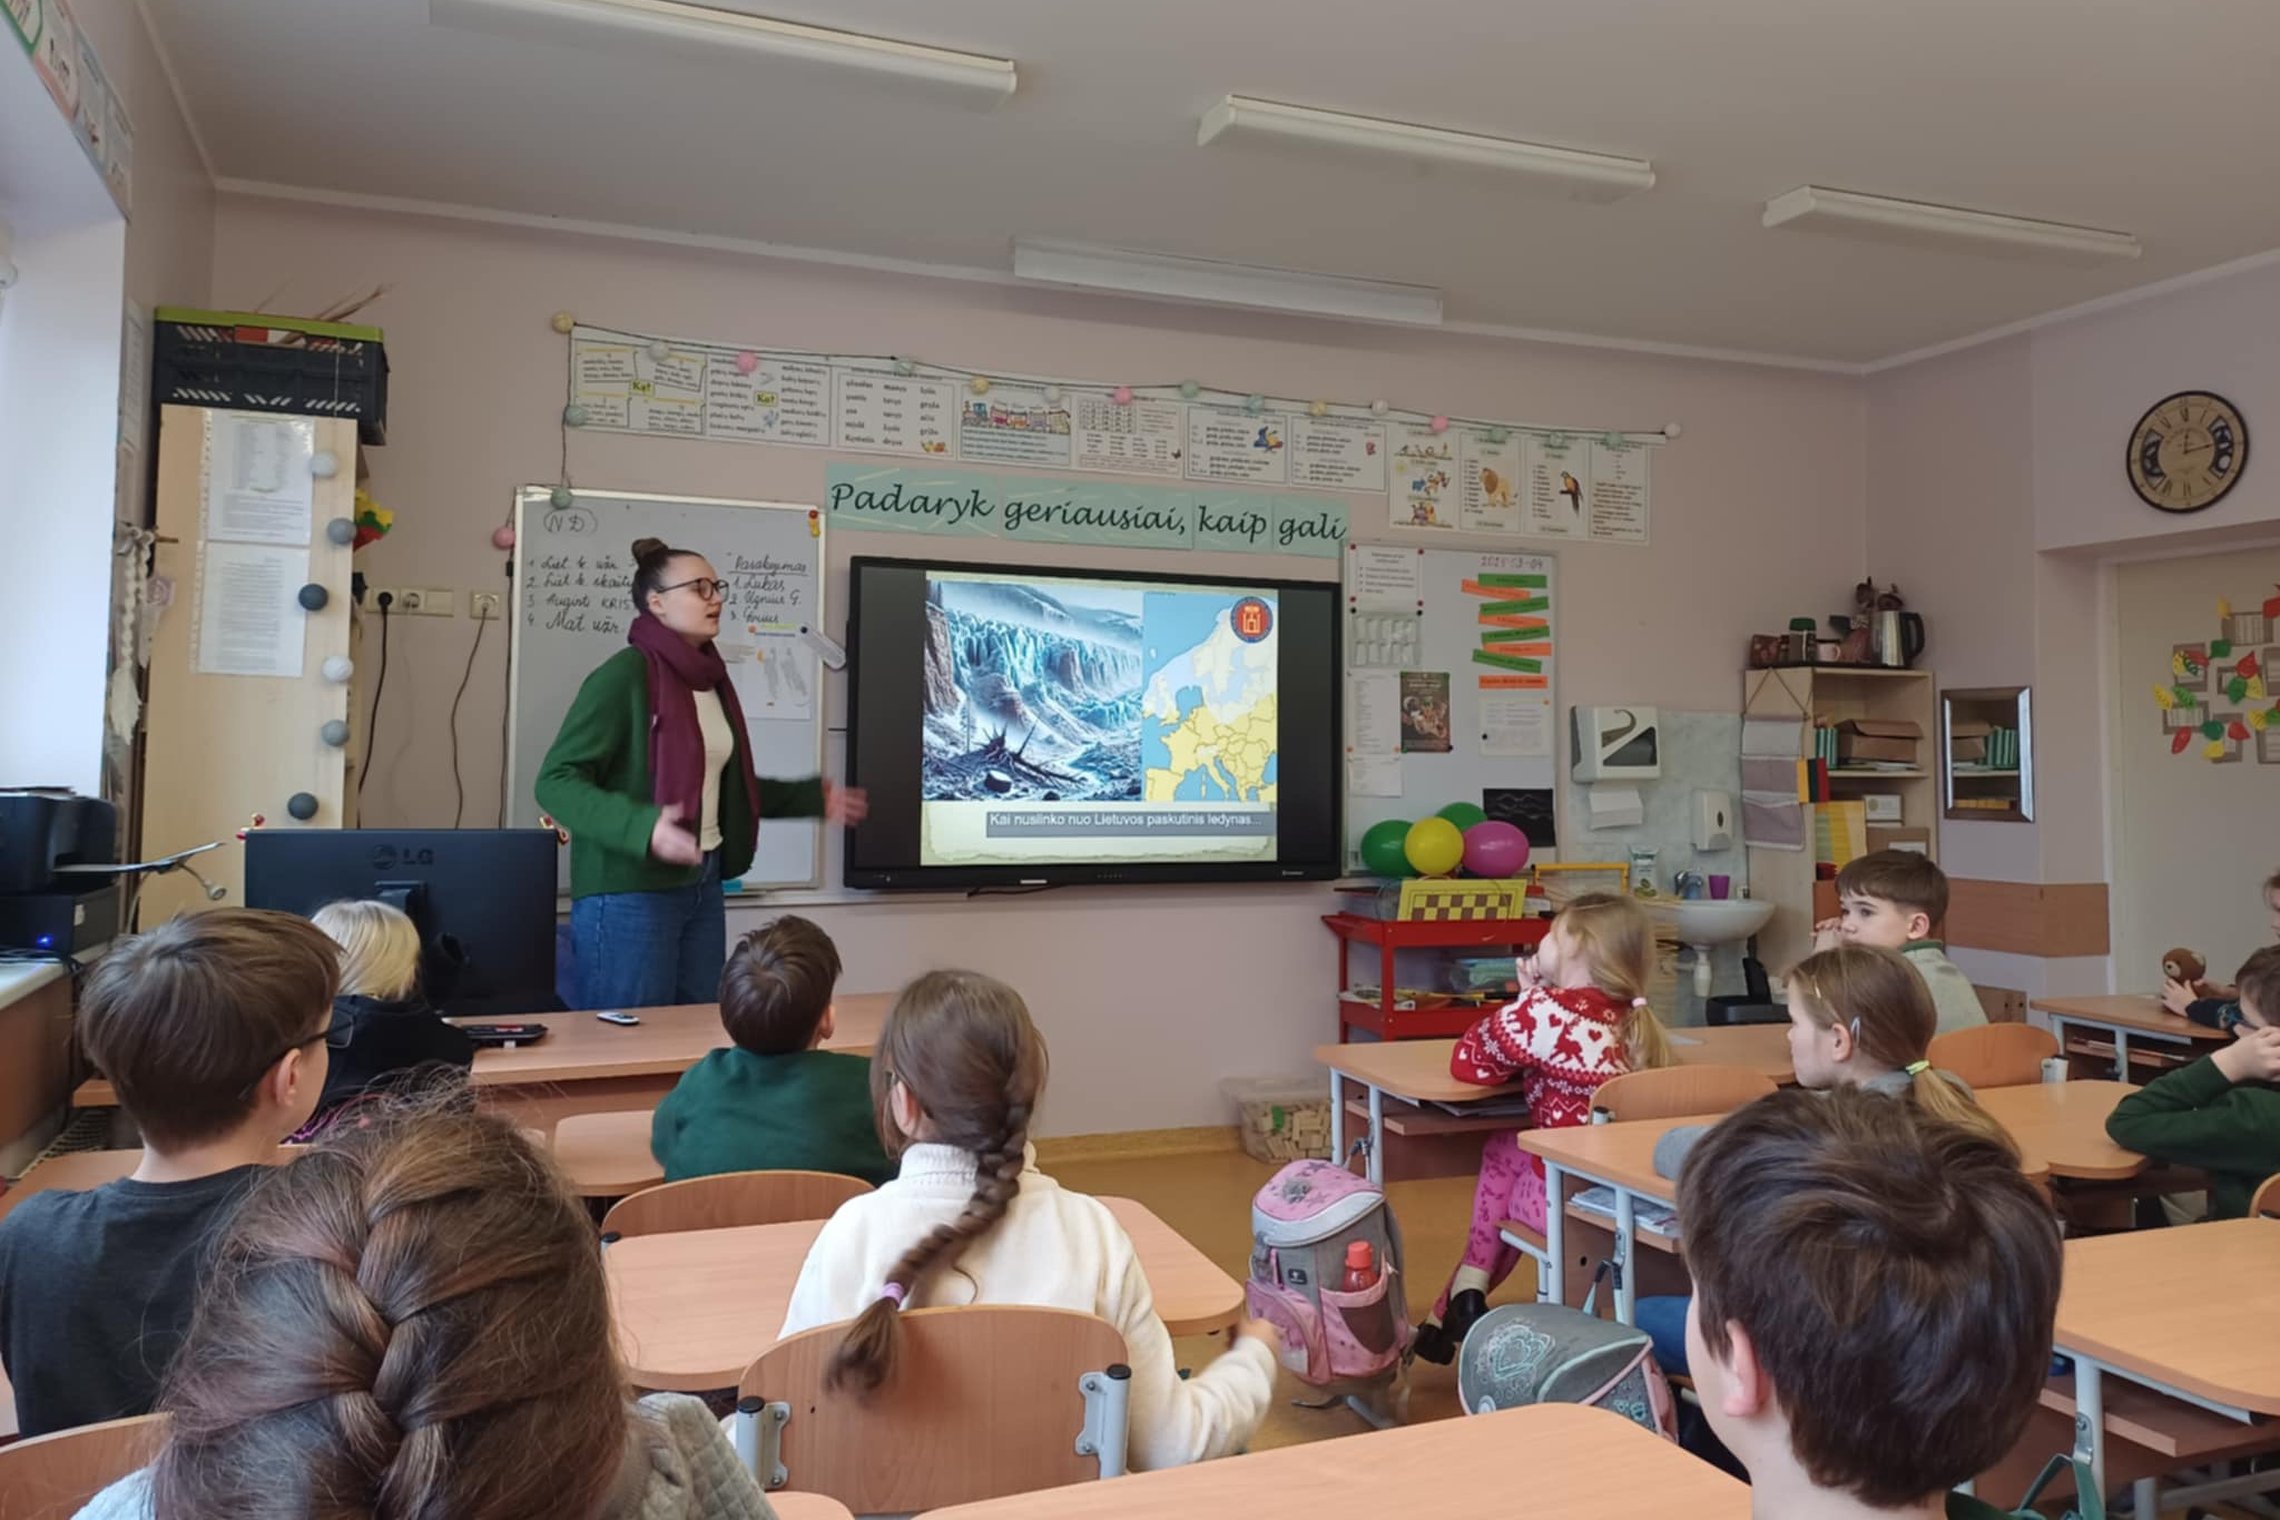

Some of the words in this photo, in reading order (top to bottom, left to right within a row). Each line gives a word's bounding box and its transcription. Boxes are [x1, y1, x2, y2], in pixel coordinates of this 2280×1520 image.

[831, 484, 994, 523] Padaryk
[1004, 500, 1185, 535] geriausiai,
[1199, 505, 1266, 542] kaip
[1279, 513, 1347, 545] gali
[990, 813, 1011, 826] Kai
[1013, 813, 1066, 826] nuslinko
[1068, 815, 1090, 826] nuo
[1095, 813, 1143, 826] Lietuvos
[1146, 813, 1204, 828] paskutinis
[401, 848, 434, 866] LG
